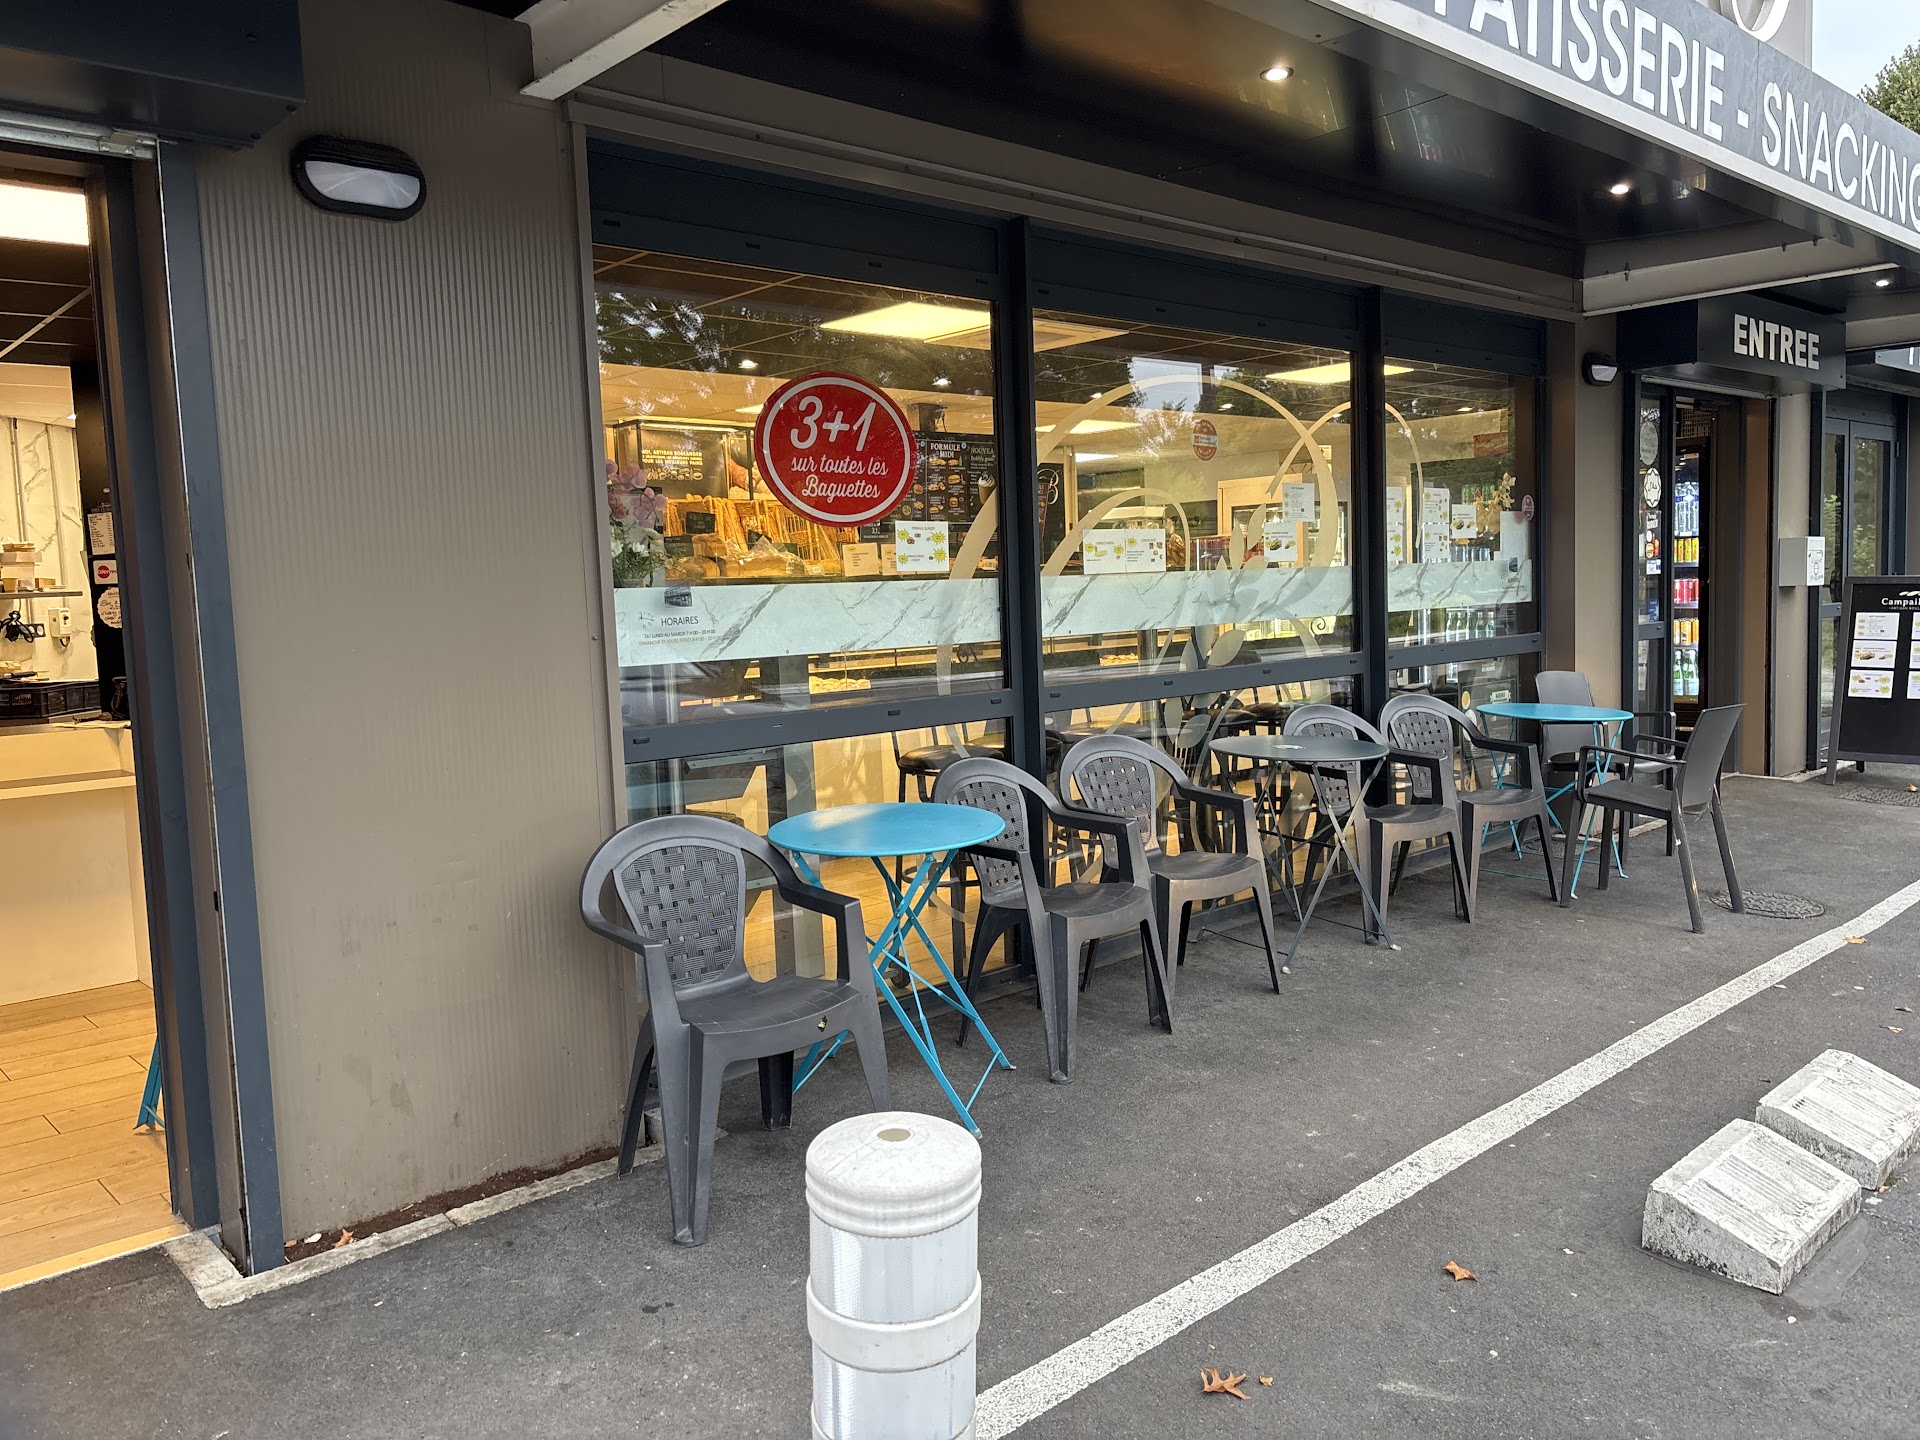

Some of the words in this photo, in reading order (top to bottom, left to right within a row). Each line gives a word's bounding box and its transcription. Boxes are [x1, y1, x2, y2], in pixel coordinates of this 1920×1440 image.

[1434, 0, 1726, 142] TISSERIE
[1733, 313, 1820, 370] ENTREE
[790, 395, 877, 452] 3+1
[930, 443, 961, 451] FORMULE
[791, 456, 817, 472] sur
[819, 454, 866, 475] toutes
[867, 457, 889, 476] les
[801, 474, 881, 504] Baguettes
[661, 615, 699, 627] HORAIRES
